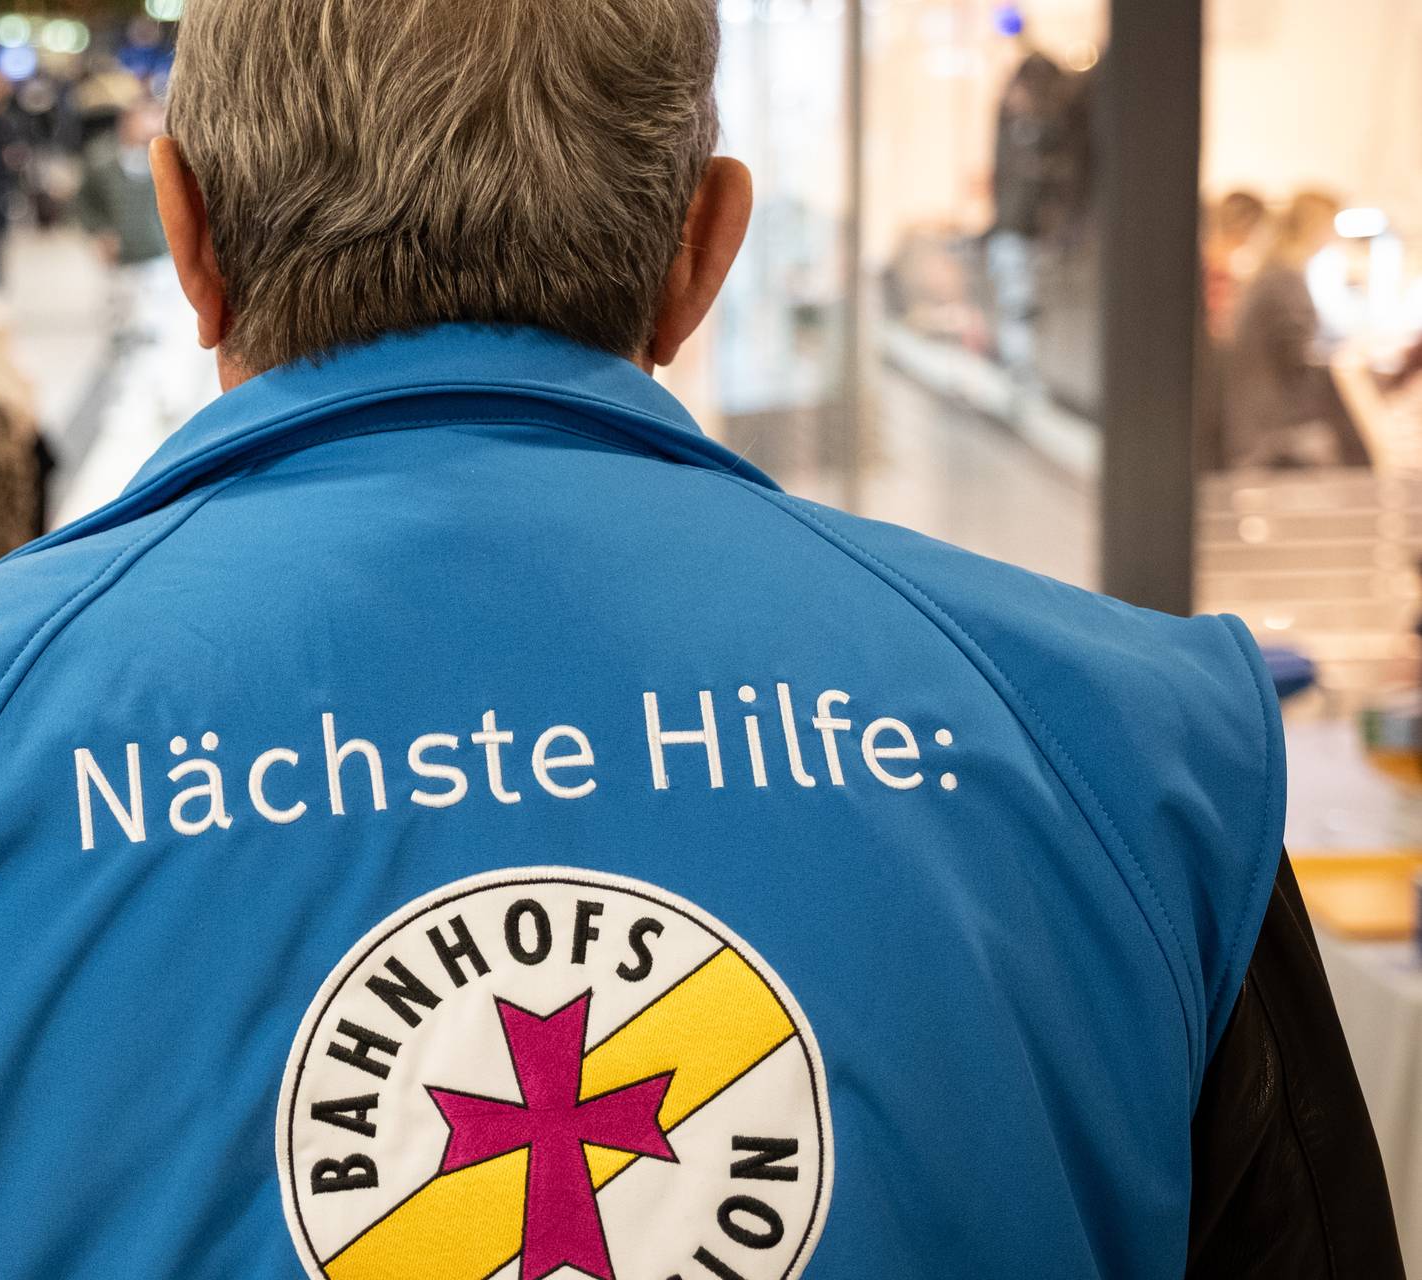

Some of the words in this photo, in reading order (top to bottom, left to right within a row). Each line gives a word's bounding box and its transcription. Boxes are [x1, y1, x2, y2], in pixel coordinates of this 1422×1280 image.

[73, 707, 598, 852] Nächste
[642, 682, 959, 792] Hilfe:
[310, 898, 666, 1196] BAHNHOFS
[666, 1135, 800, 1280] ION
